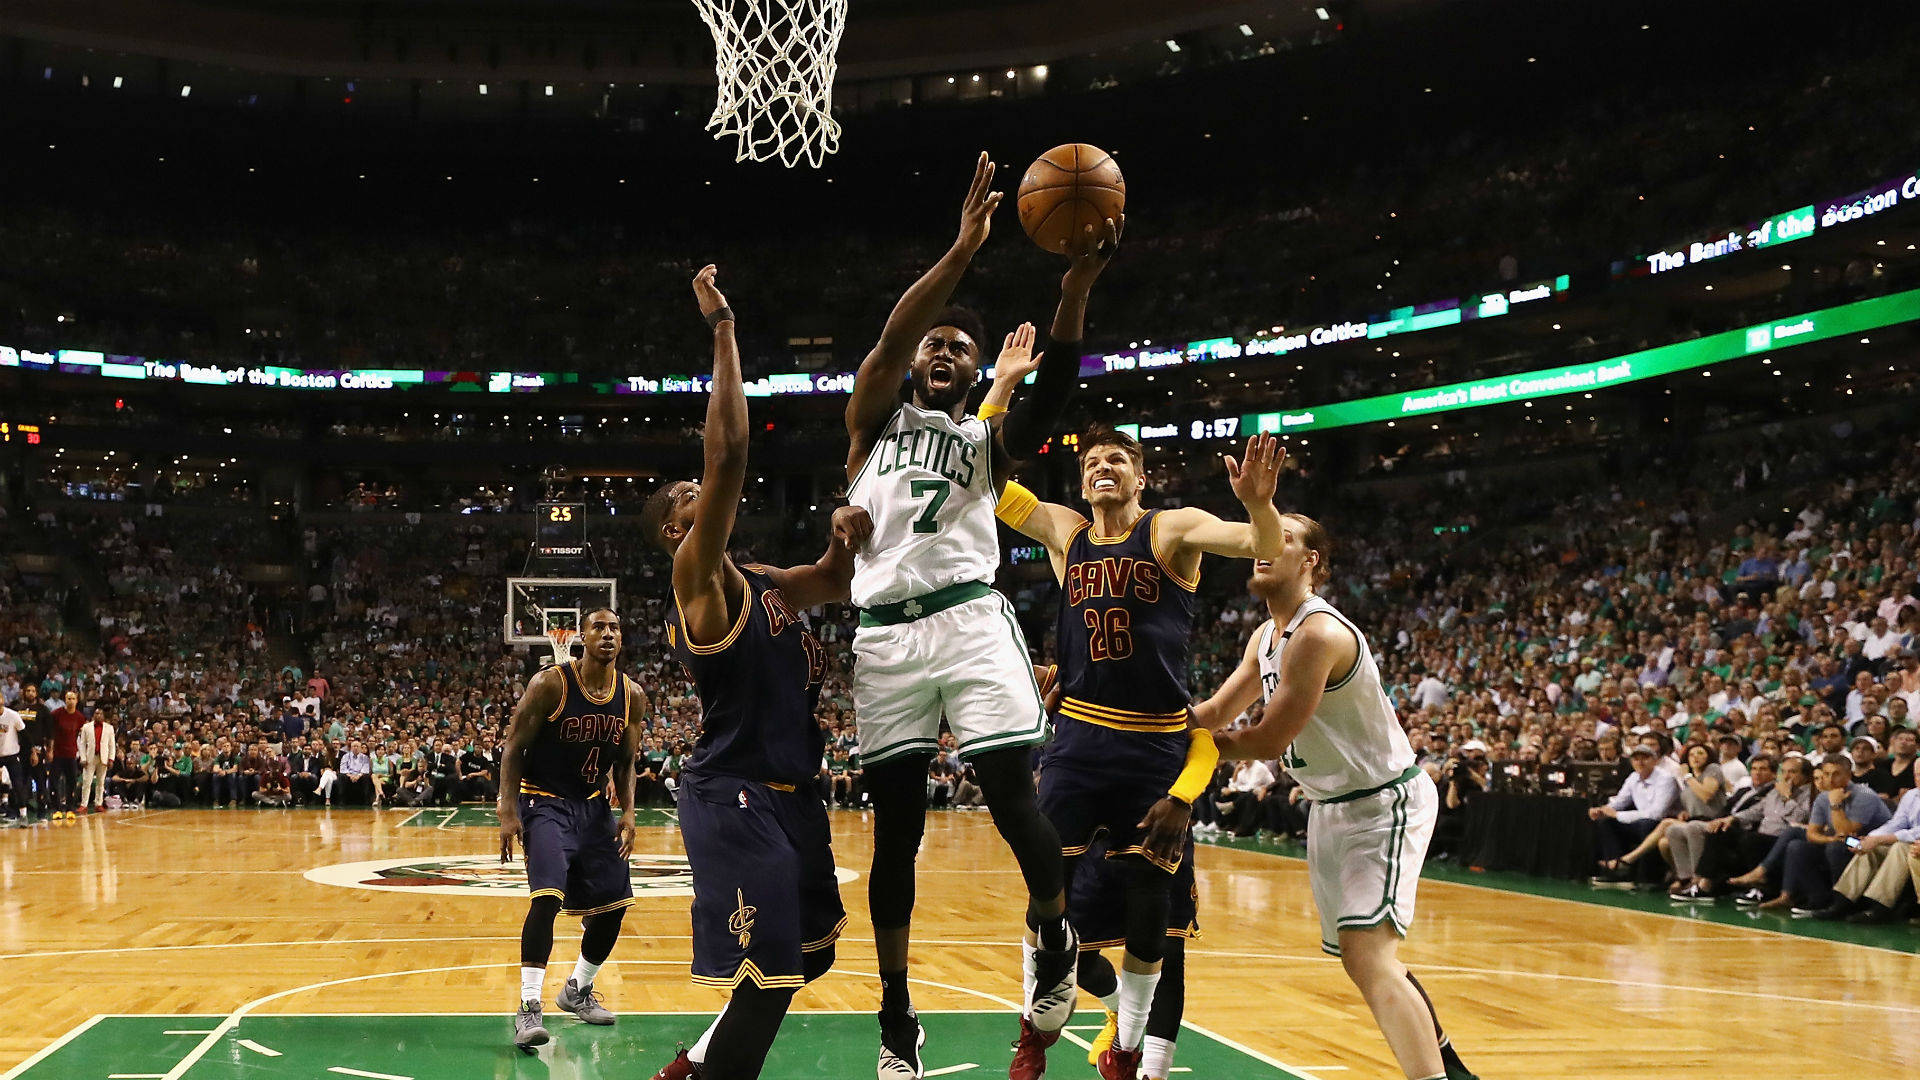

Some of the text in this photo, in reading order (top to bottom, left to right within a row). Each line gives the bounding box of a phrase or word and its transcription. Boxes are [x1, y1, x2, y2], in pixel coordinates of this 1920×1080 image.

[1647, 251, 1685, 274] The
[1690, 232, 1742, 263] Bank
[1747, 221, 1772, 248] of
[1776, 215, 1815, 239] the
[1821, 188, 1897, 228] Boston
[1102, 353, 1136, 373] The
[1139, 350, 1183, 368] Bank
[1210, 341, 1241, 359] the
[1246, 333, 1307, 357] Boston
[1310, 321, 1368, 346] Celtics
[1774, 320, 1814, 339] Bank
[144, 360, 393, 389] The Bank of the Boston Celtics
[628, 376, 658, 392] The
[662, 377, 702, 392] Bank
[1401, 360, 1632, 412] America's Most Convenient Bank
[1190, 417, 1239, 440] 8:57
[877, 425, 976, 489] CELTICS
[550, 506, 571, 522] 2.5
[910, 479, 951, 534] 7
[551, 547, 583, 555] TISSOT
[1068, 557, 1160, 607] CAVS
[1084, 607, 1133, 662] 26
[559, 713, 626, 745] CAVS
[581, 746, 599, 783] 4
